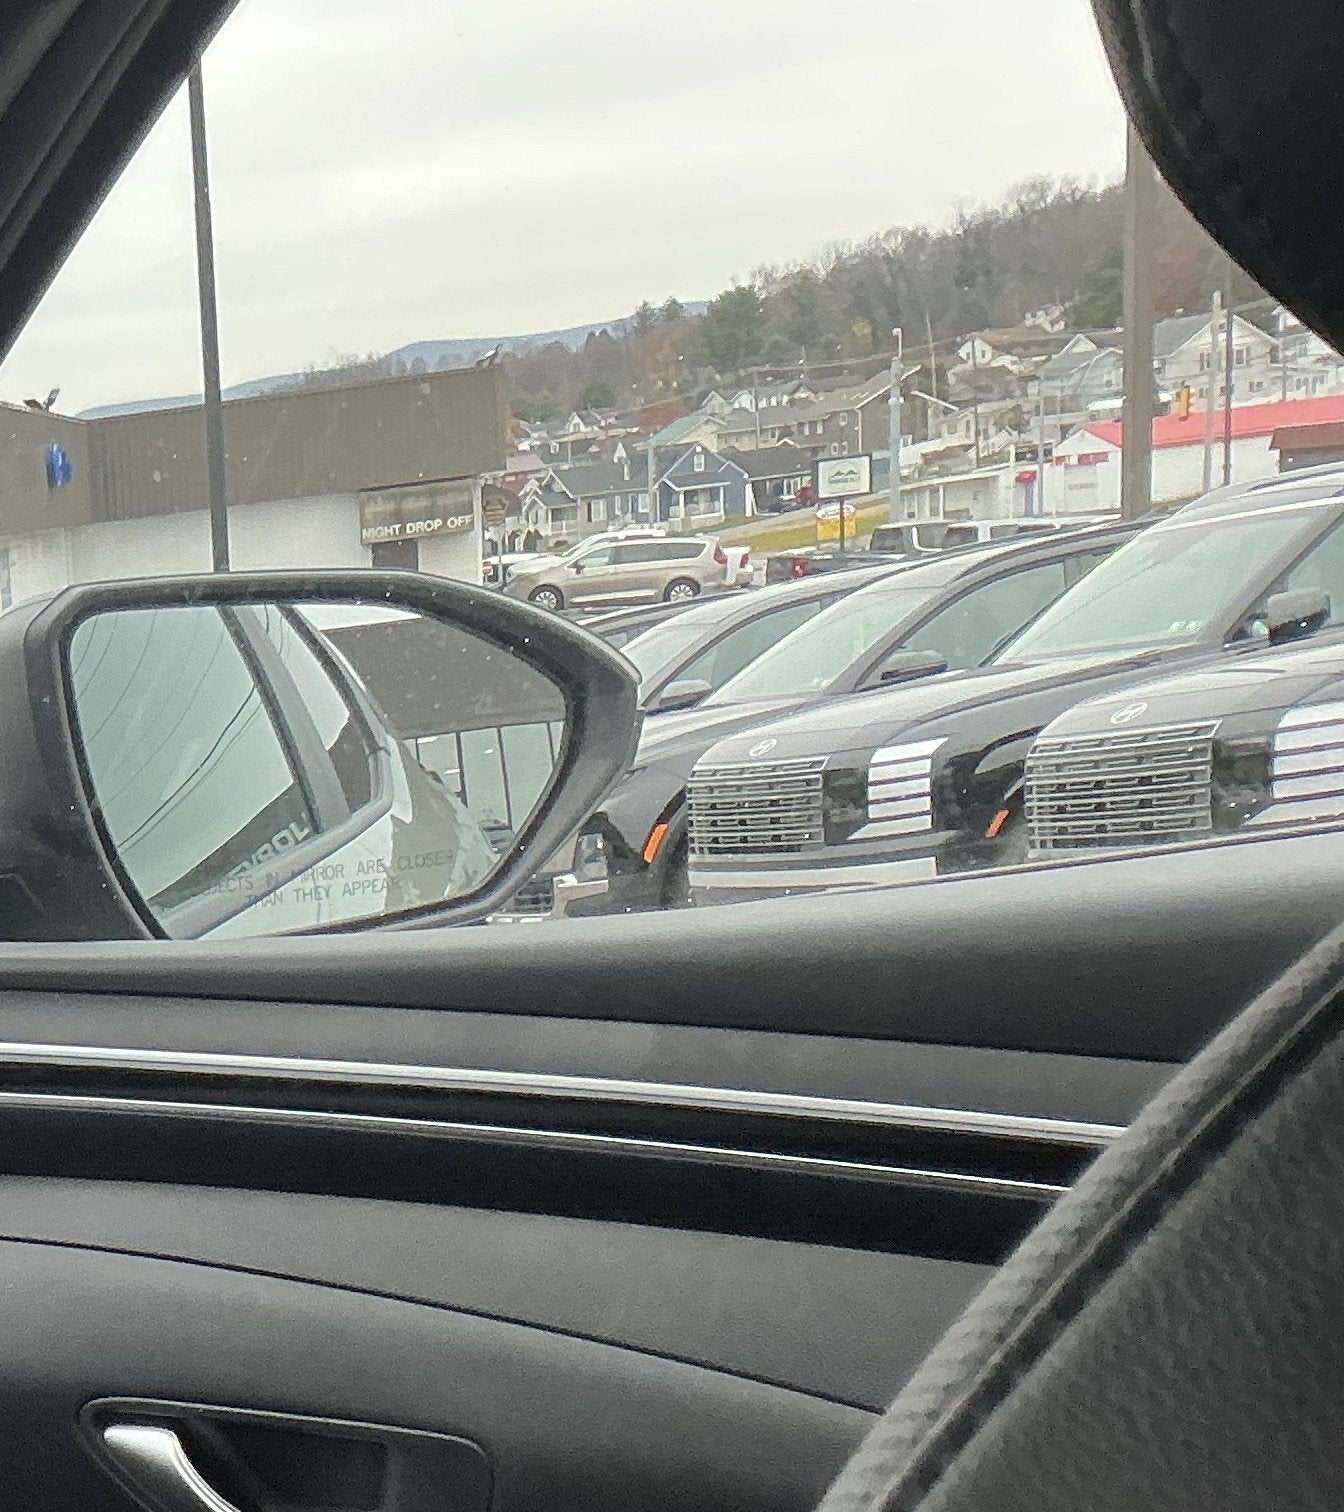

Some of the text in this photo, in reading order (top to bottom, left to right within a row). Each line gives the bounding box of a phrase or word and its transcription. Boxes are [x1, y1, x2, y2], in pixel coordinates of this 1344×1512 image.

[361, 513, 474, 540] NIGHT DROP OFF
[356, 857, 385, 876] ARE
[292, 883, 333, 902] THEY
